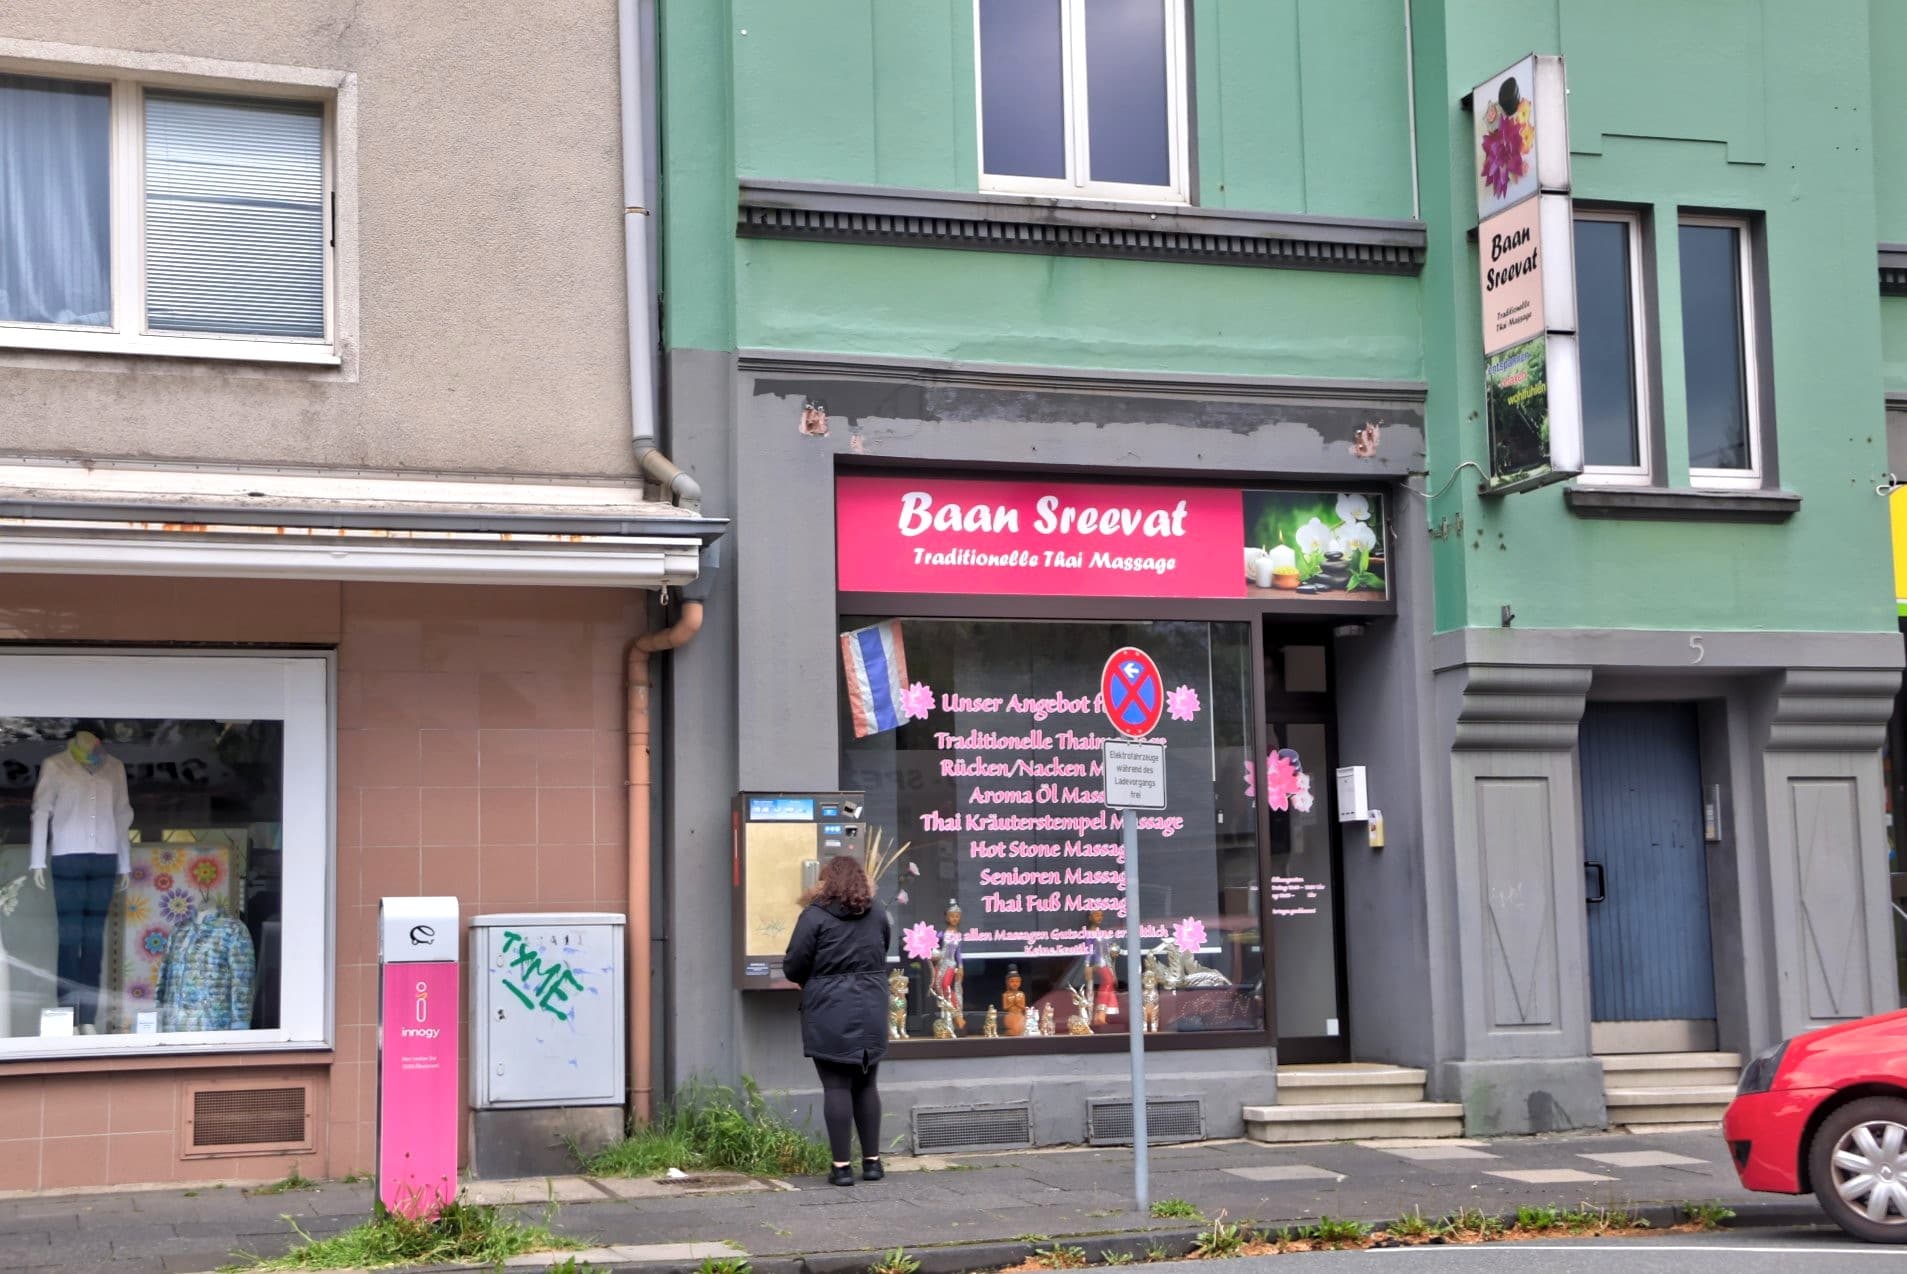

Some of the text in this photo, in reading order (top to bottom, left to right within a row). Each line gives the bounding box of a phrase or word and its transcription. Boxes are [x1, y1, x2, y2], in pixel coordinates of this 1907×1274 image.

[1491, 227, 1530, 262] Baan
[1486, 247, 1538, 292] Sreevat
[898, 491, 1188, 537] Baan Sreevat
[913, 547, 1177, 575] Traditionelle Thai Massage
[1689, 634, 1705, 664] 5
[941, 692, 1004, 713] Unser
[1005, 690, 1091, 721] Angebot
[933, 728, 1054, 750] Traditionelle
[939, 755, 1087, 778] Rücken/Nacken
[968, 783, 1105, 805] Aroma Öl Mass
[919, 809, 1184, 837] Thai Kräuterstempel Mssage
[969, 840, 1126, 864] Hot Stone Massag
[979, 866, 1127, 892] Senioren Massag
[981, 892, 1127, 918] Thai Fuß Massag
[963, 928, 993, 942] allen
[994, 929, 1050, 945] Massagen
[401, 1026, 441, 1039] innogy
